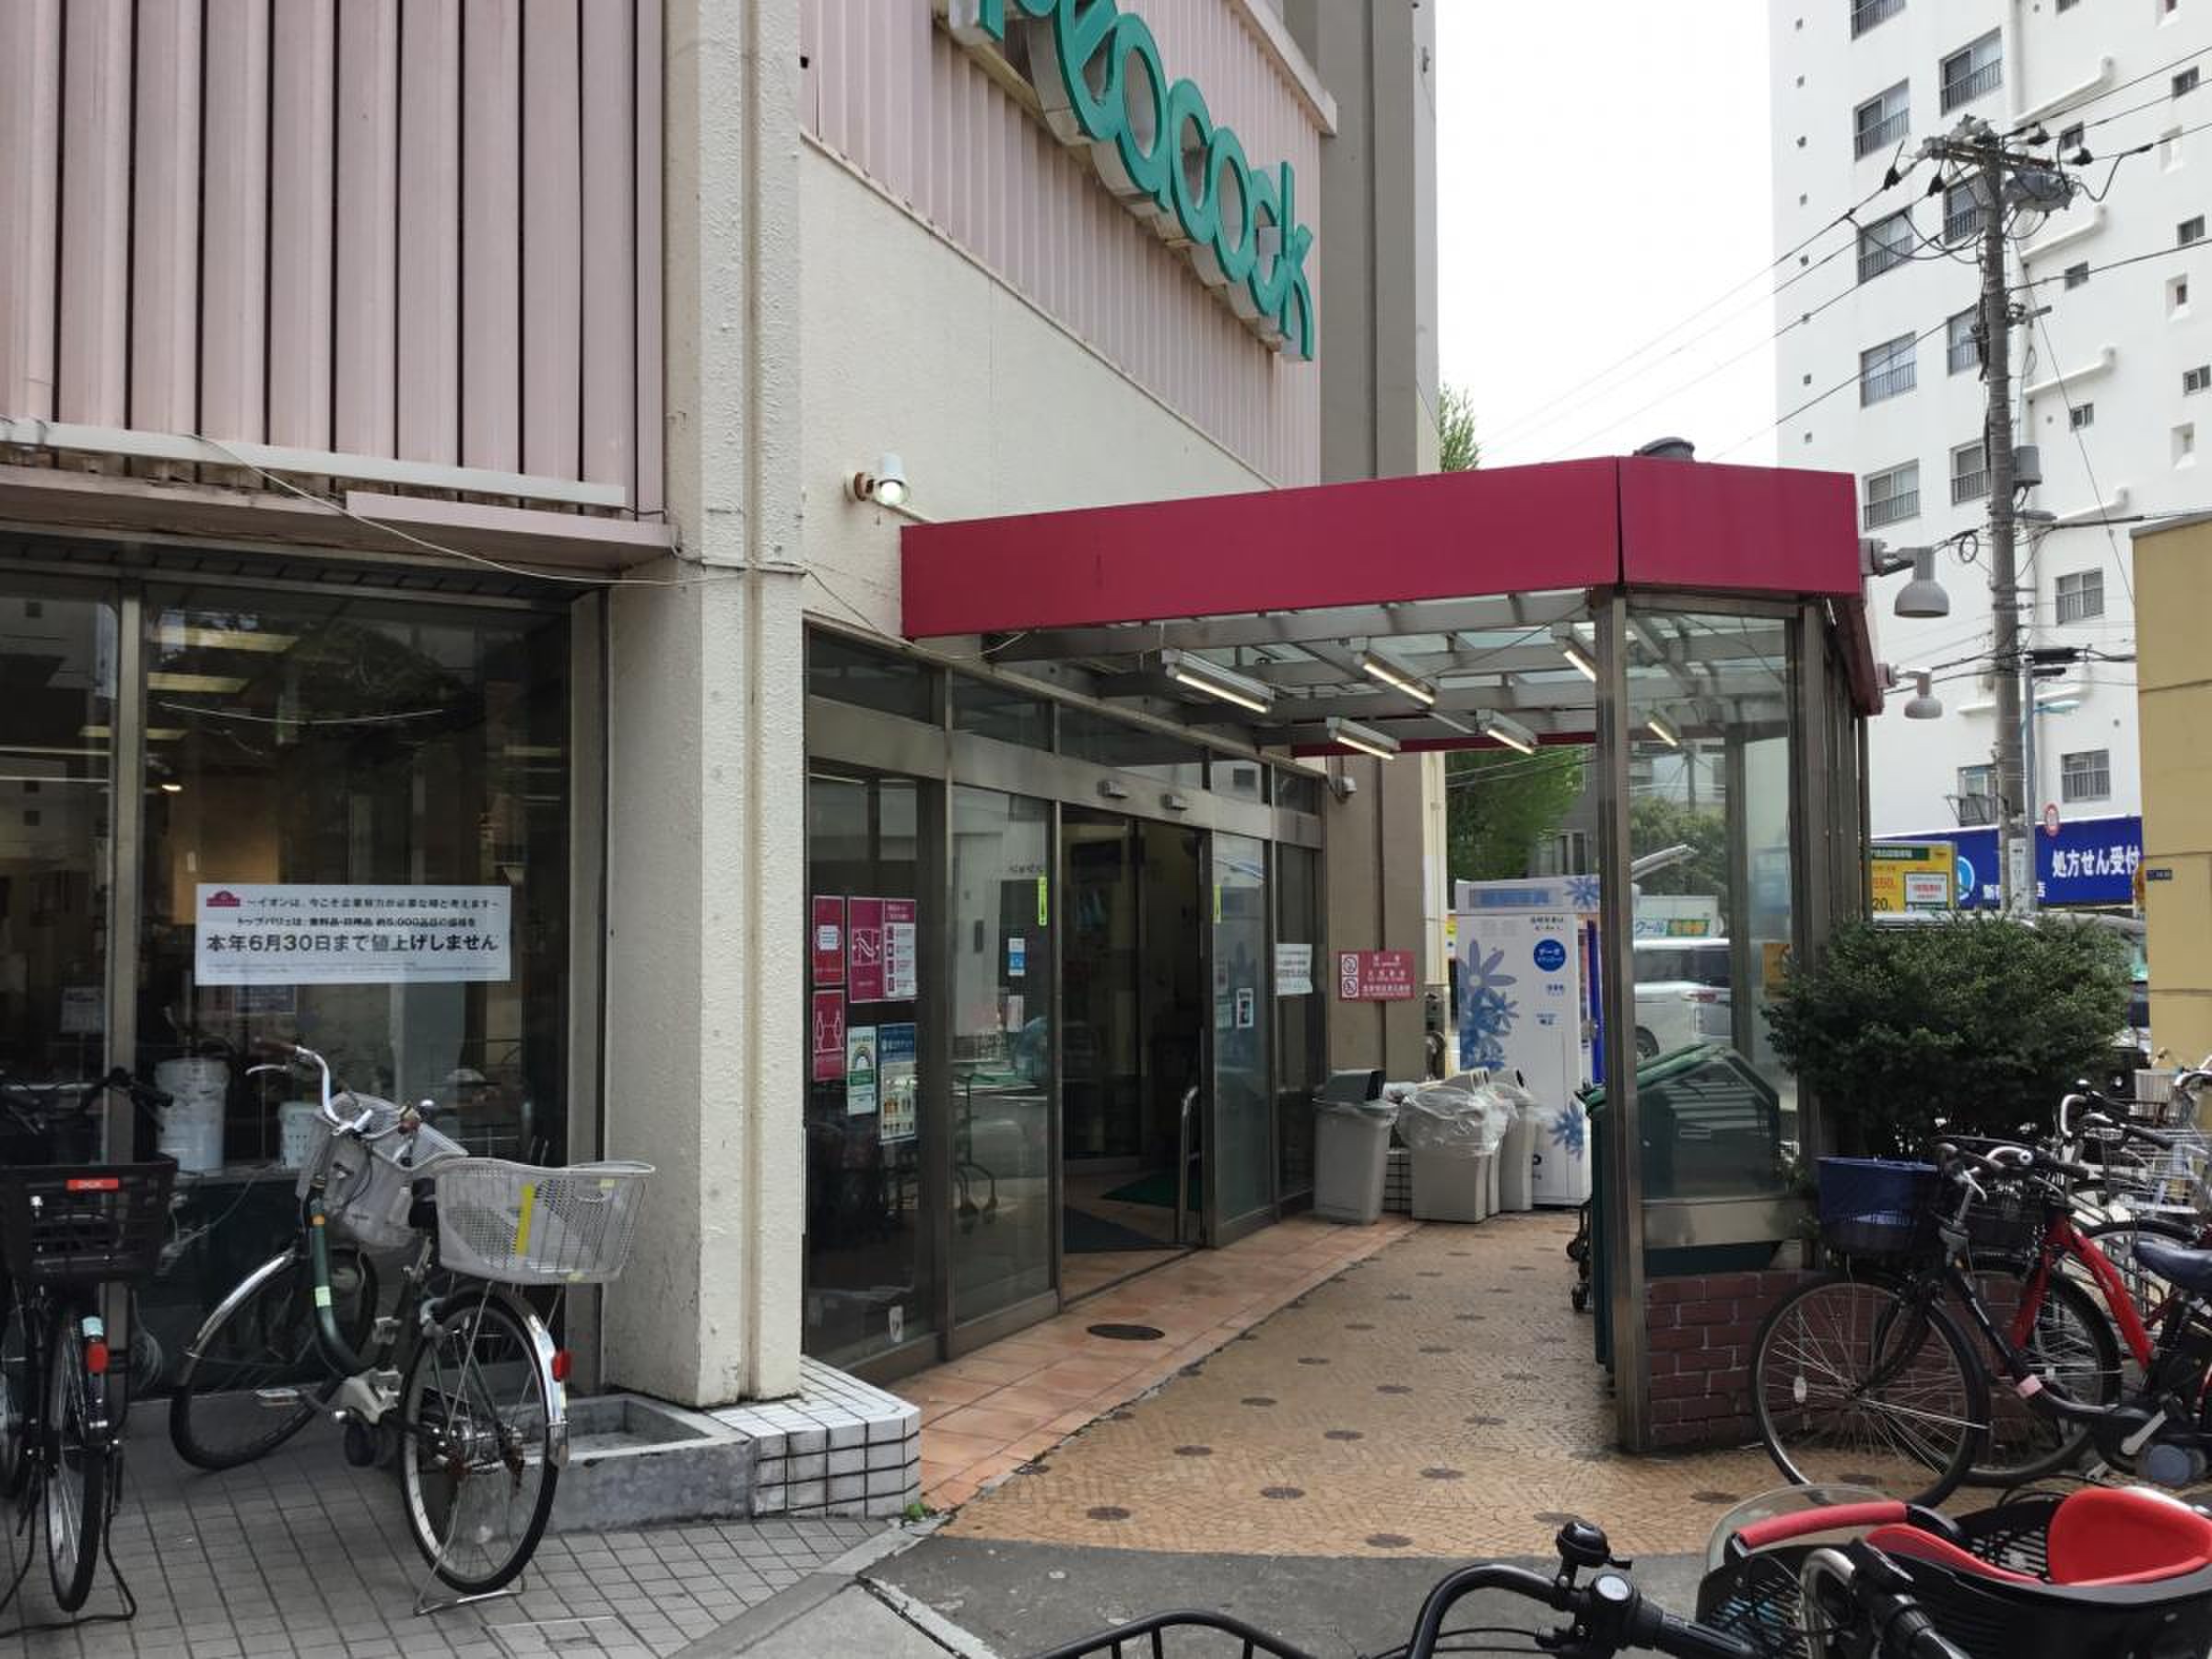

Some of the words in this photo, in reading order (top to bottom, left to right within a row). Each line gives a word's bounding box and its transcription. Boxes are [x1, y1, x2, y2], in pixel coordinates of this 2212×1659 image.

[2053, 845, 2140, 878] 処方せん受付
[206, 934, 500, 952] 本年6月30日まで値上げしません
